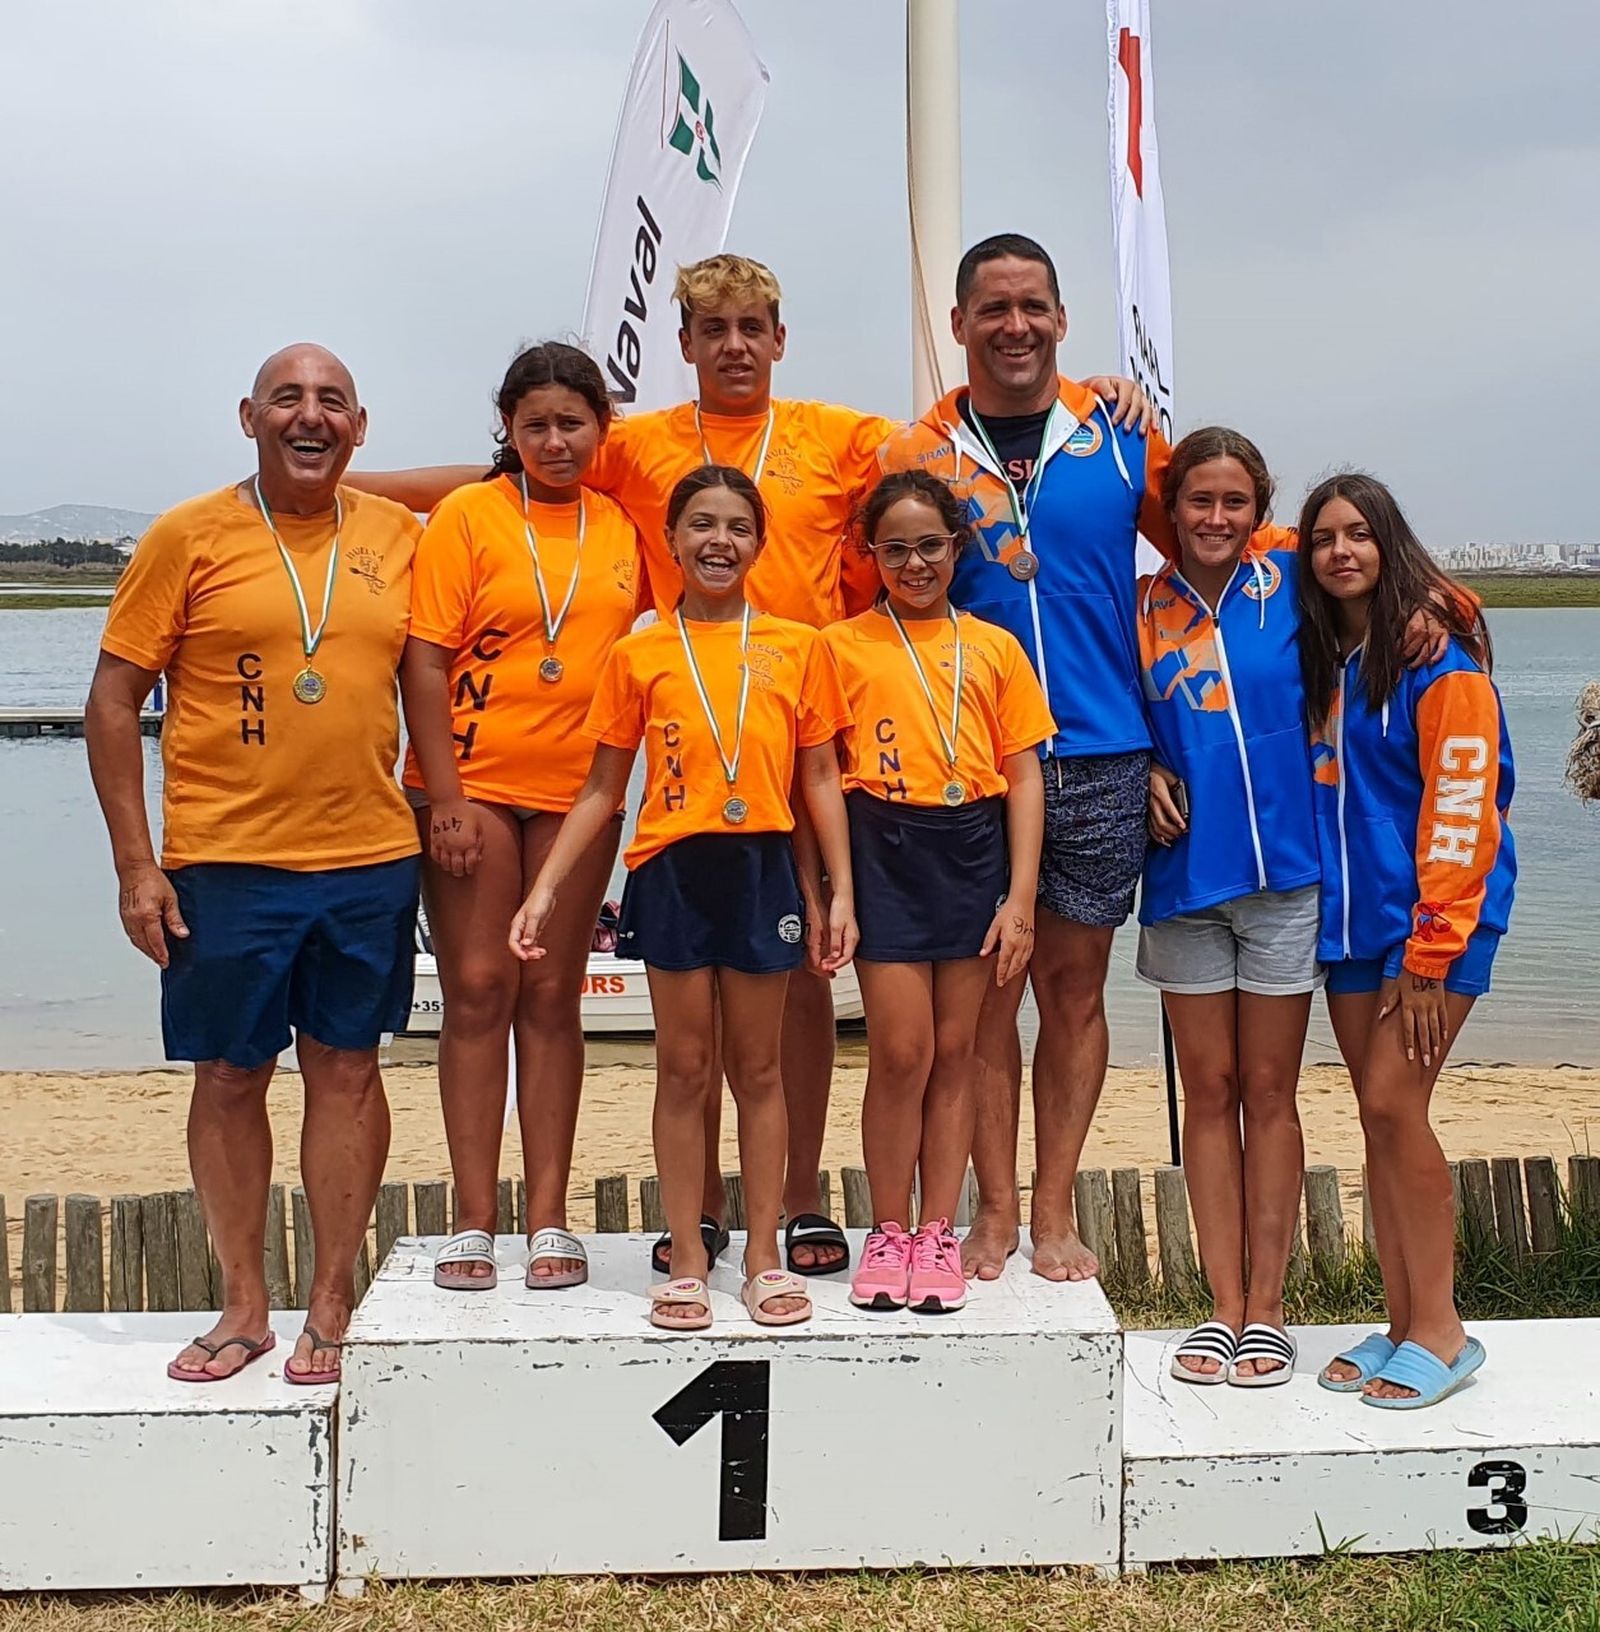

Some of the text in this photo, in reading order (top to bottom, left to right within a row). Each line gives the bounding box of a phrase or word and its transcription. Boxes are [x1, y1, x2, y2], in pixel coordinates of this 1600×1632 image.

[916, 445, 955, 465] BRAV
[236, 653, 266, 745] CNH
[663, 722, 686, 812] CNH
[874, 718, 908, 801] CNH
[1427, 734, 1489, 868] CNH
[412, 1000, 444, 1012] +35
[651, 1359, 771, 1541] 1
[1466, 1460, 1528, 1535] 3
